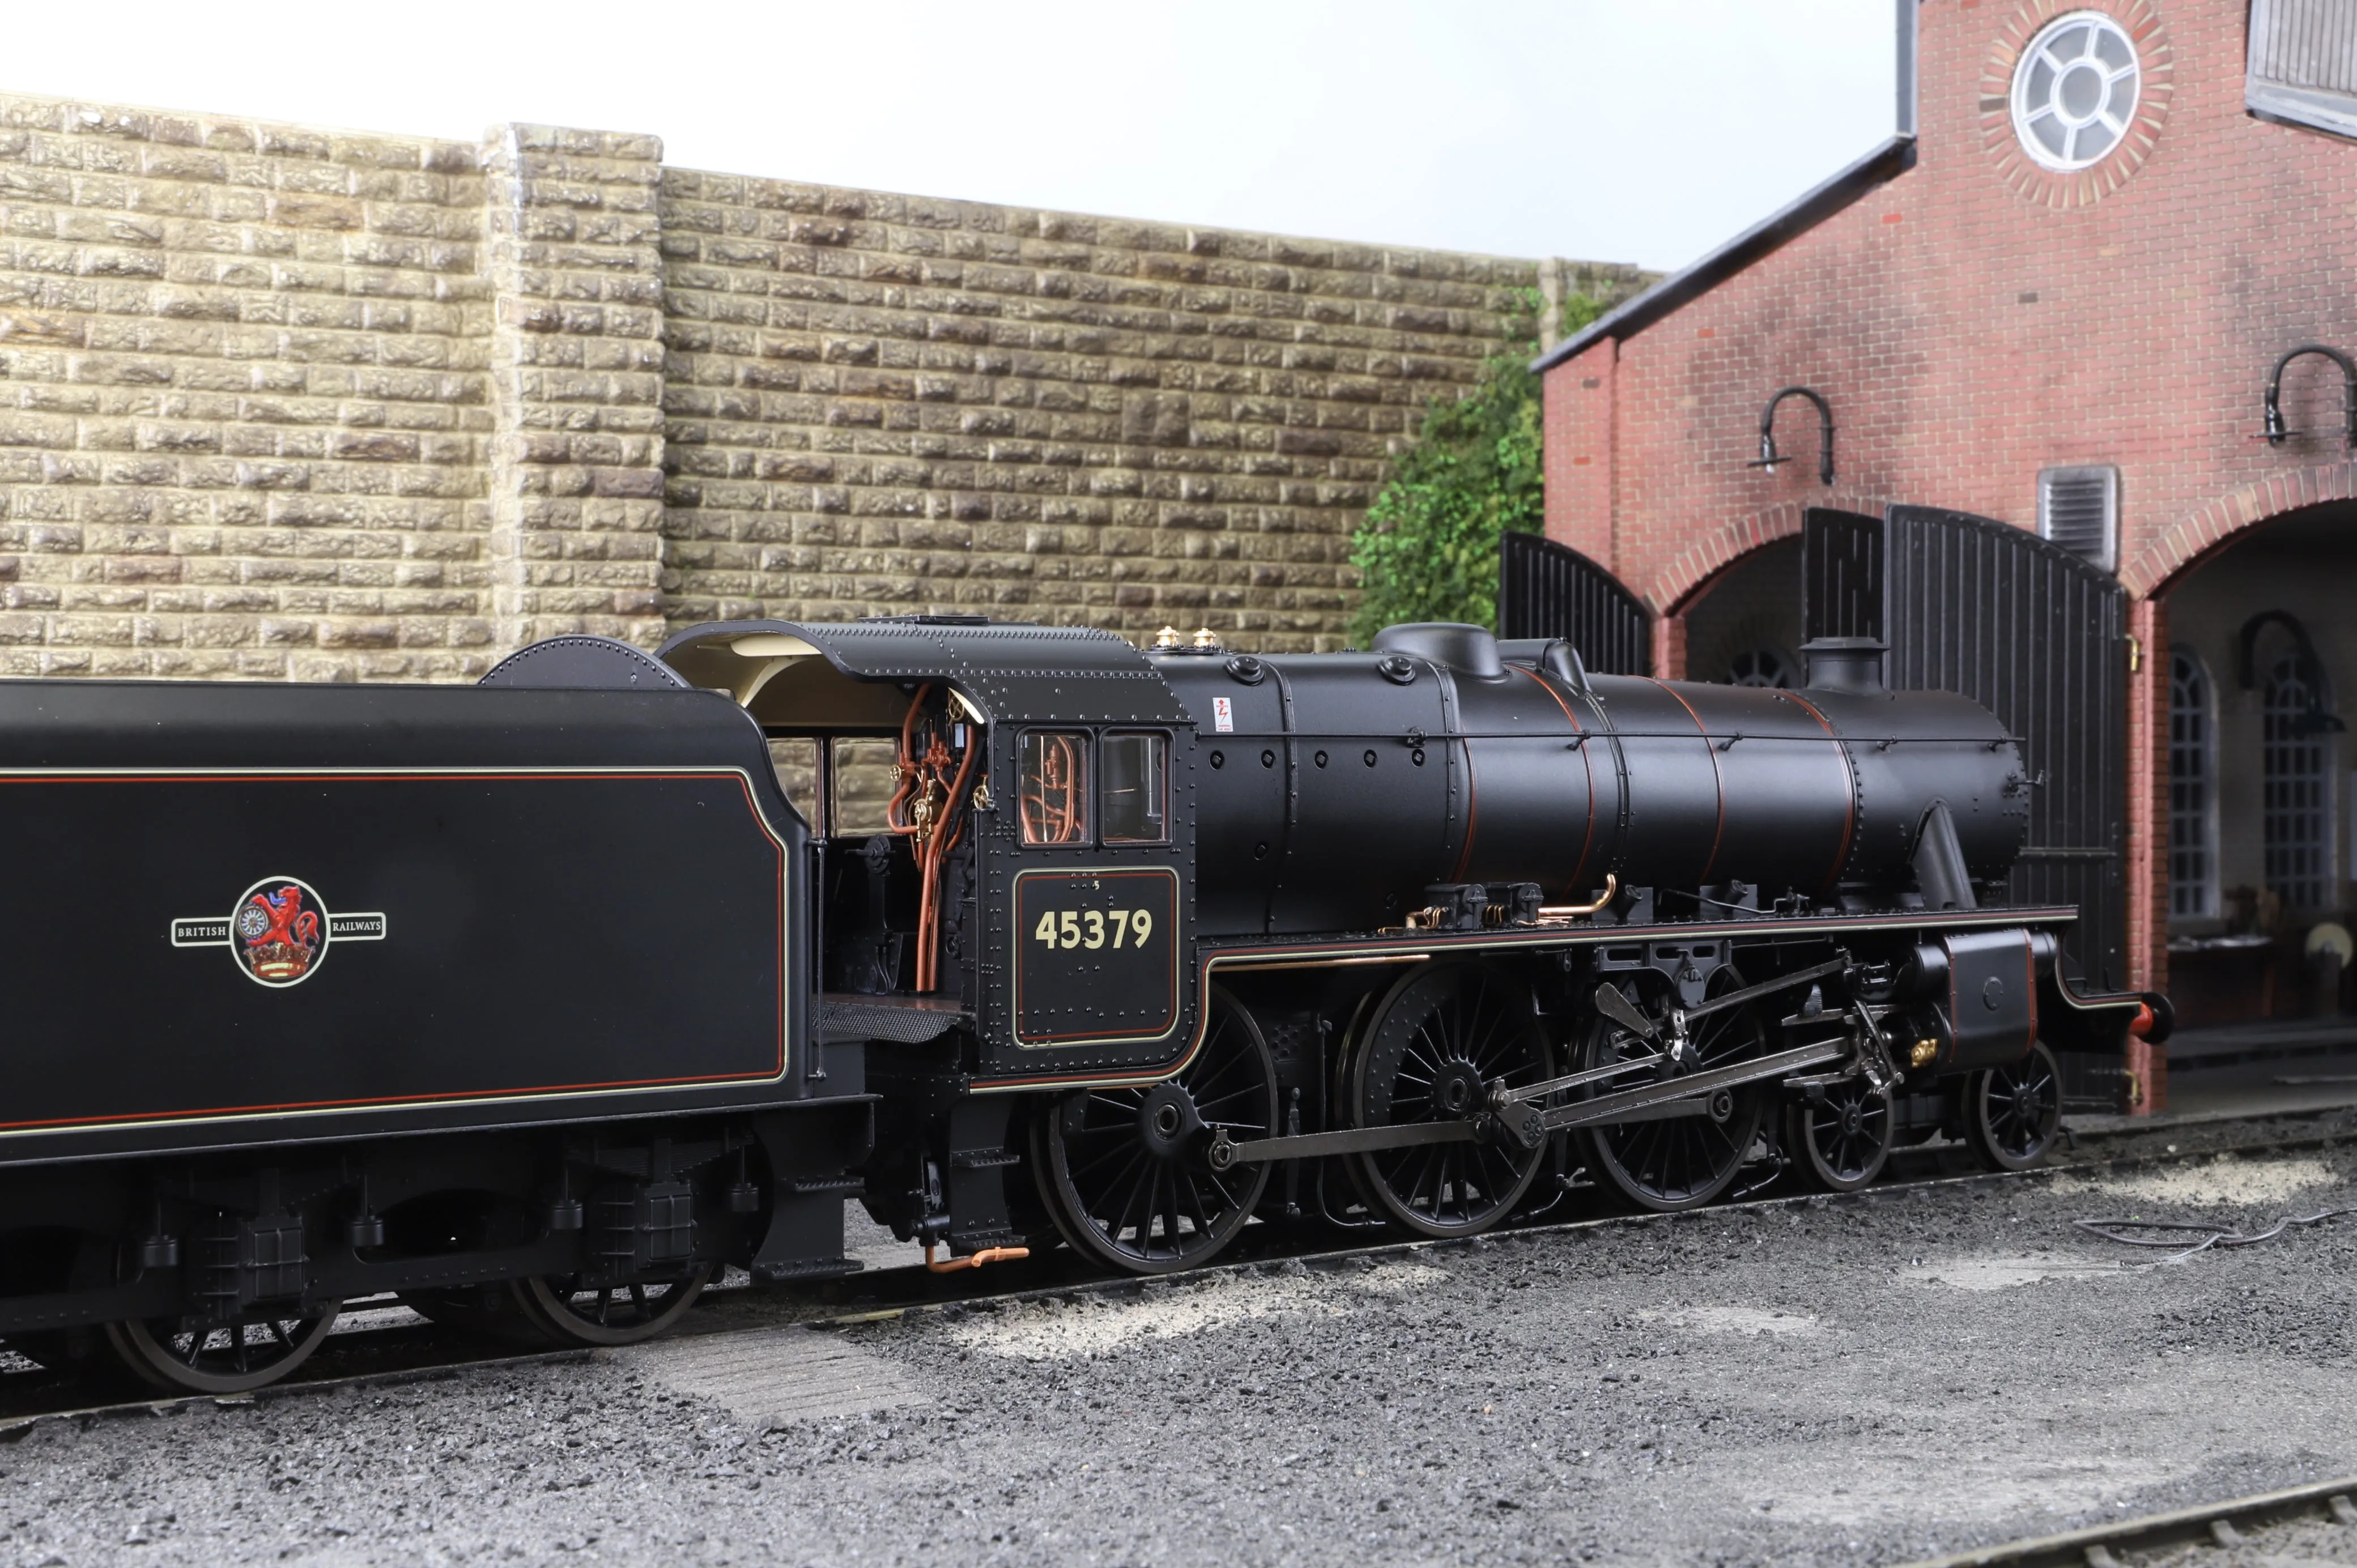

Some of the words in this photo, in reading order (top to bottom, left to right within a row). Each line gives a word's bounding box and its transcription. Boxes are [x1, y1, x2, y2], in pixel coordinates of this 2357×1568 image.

[1094, 880, 1100, 890] 5
[178, 926, 226, 937] BRITISH
[333, 921, 381, 932] RAILWAYS
[1035, 909, 1152, 949] 45379
